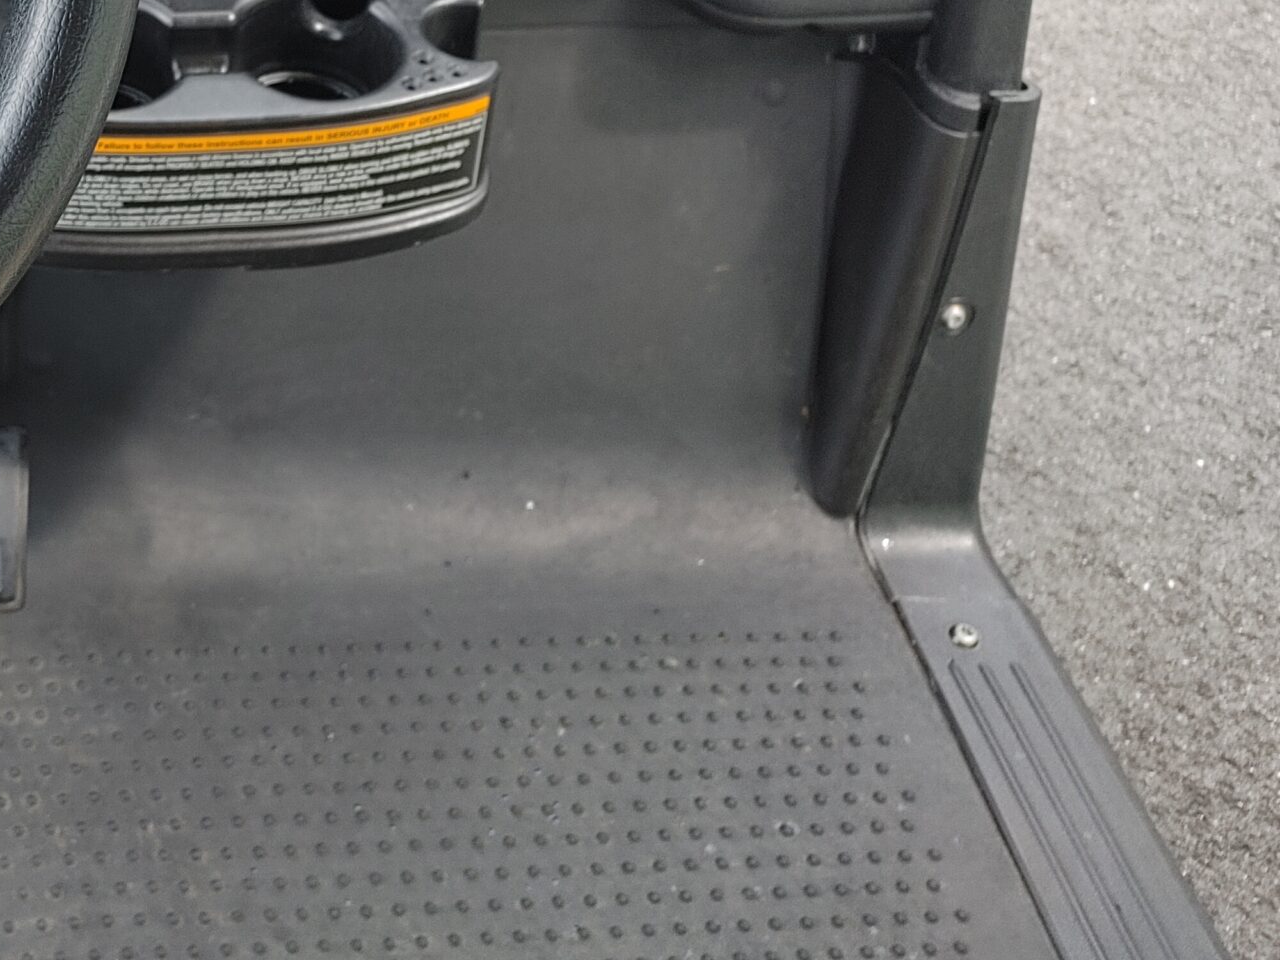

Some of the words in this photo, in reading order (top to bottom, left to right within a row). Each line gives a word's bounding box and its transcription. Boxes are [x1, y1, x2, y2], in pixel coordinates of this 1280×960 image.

[97, 141, 131, 150] Failure
[145, 141, 174, 150] follow
[177, 141, 204, 149] these
[206, 138, 263, 149] instructions
[265, 137, 283, 145] can
[285, 135, 313, 144] result
[326, 128, 370, 140] SERIOUS
[372, 122, 406, 134] INJURY
[419, 112, 450, 124] DEATH
